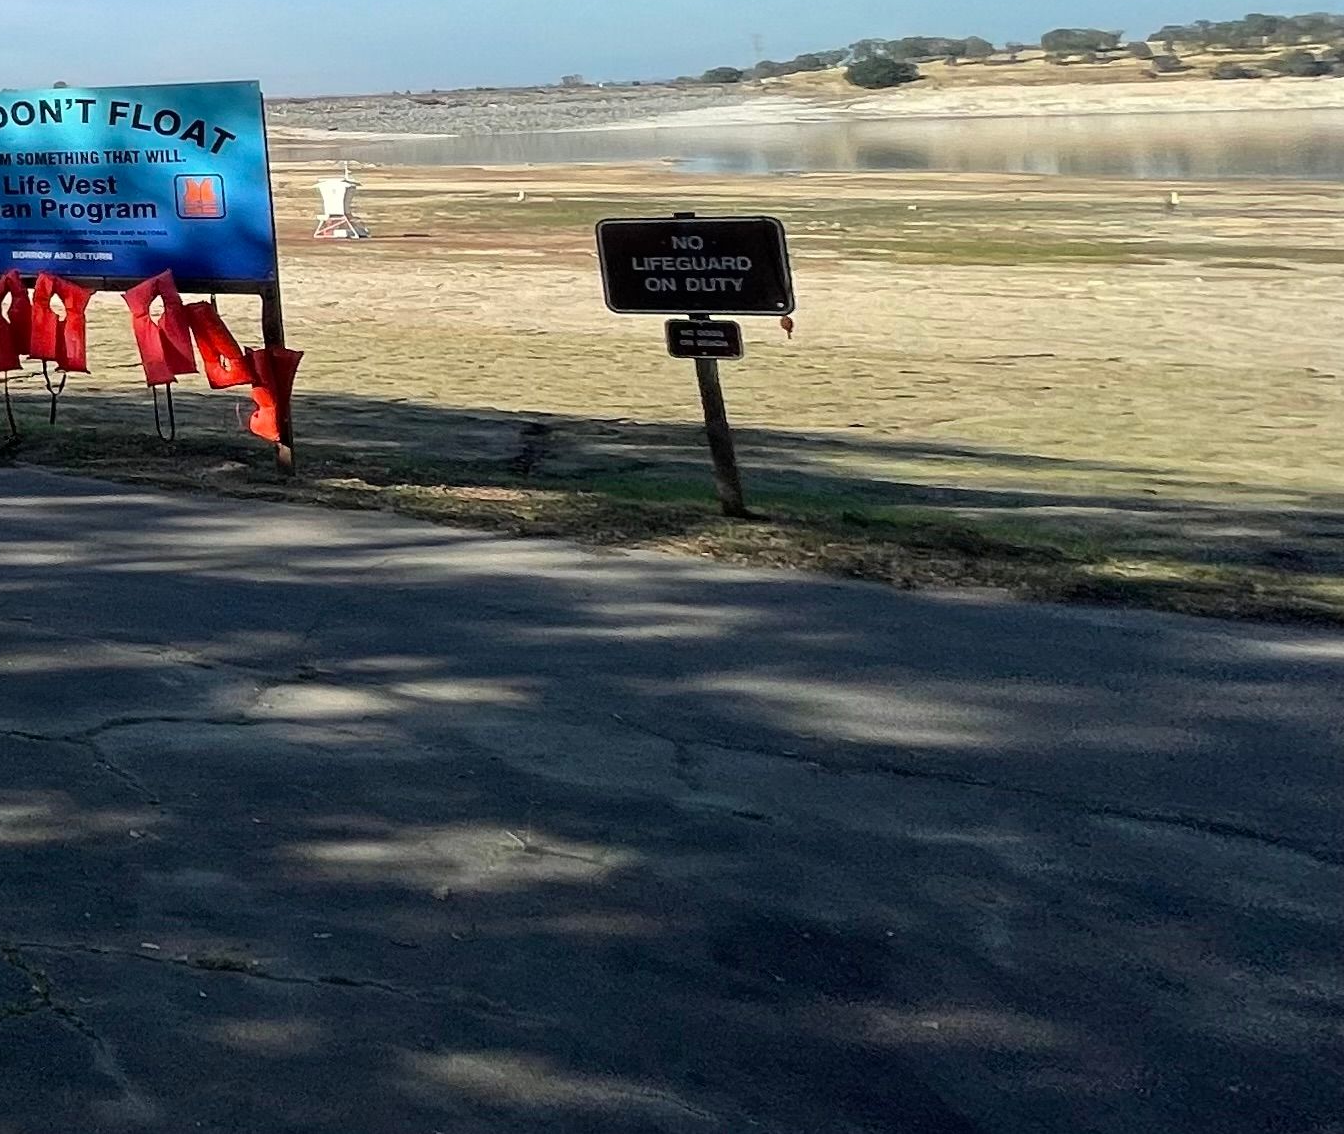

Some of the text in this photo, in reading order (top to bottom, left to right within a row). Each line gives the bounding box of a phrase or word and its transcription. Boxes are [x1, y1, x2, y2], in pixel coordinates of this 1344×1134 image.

[108, 101, 236, 155] FLOAT
[16, 150, 100, 165] SOMETHING
[103, 150, 143, 164] THAT
[146, 149, 187, 164] WILL.
[3, 174, 117, 196] Life Vest
[40, 199, 157, 224] Program
[671, 235, 704, 250] NO
[12, 251, 113, 261] BORROW AND RETURN
[631, 256, 752, 272] LIFEGUARD
[644, 277, 744, 292] ON DUTY
